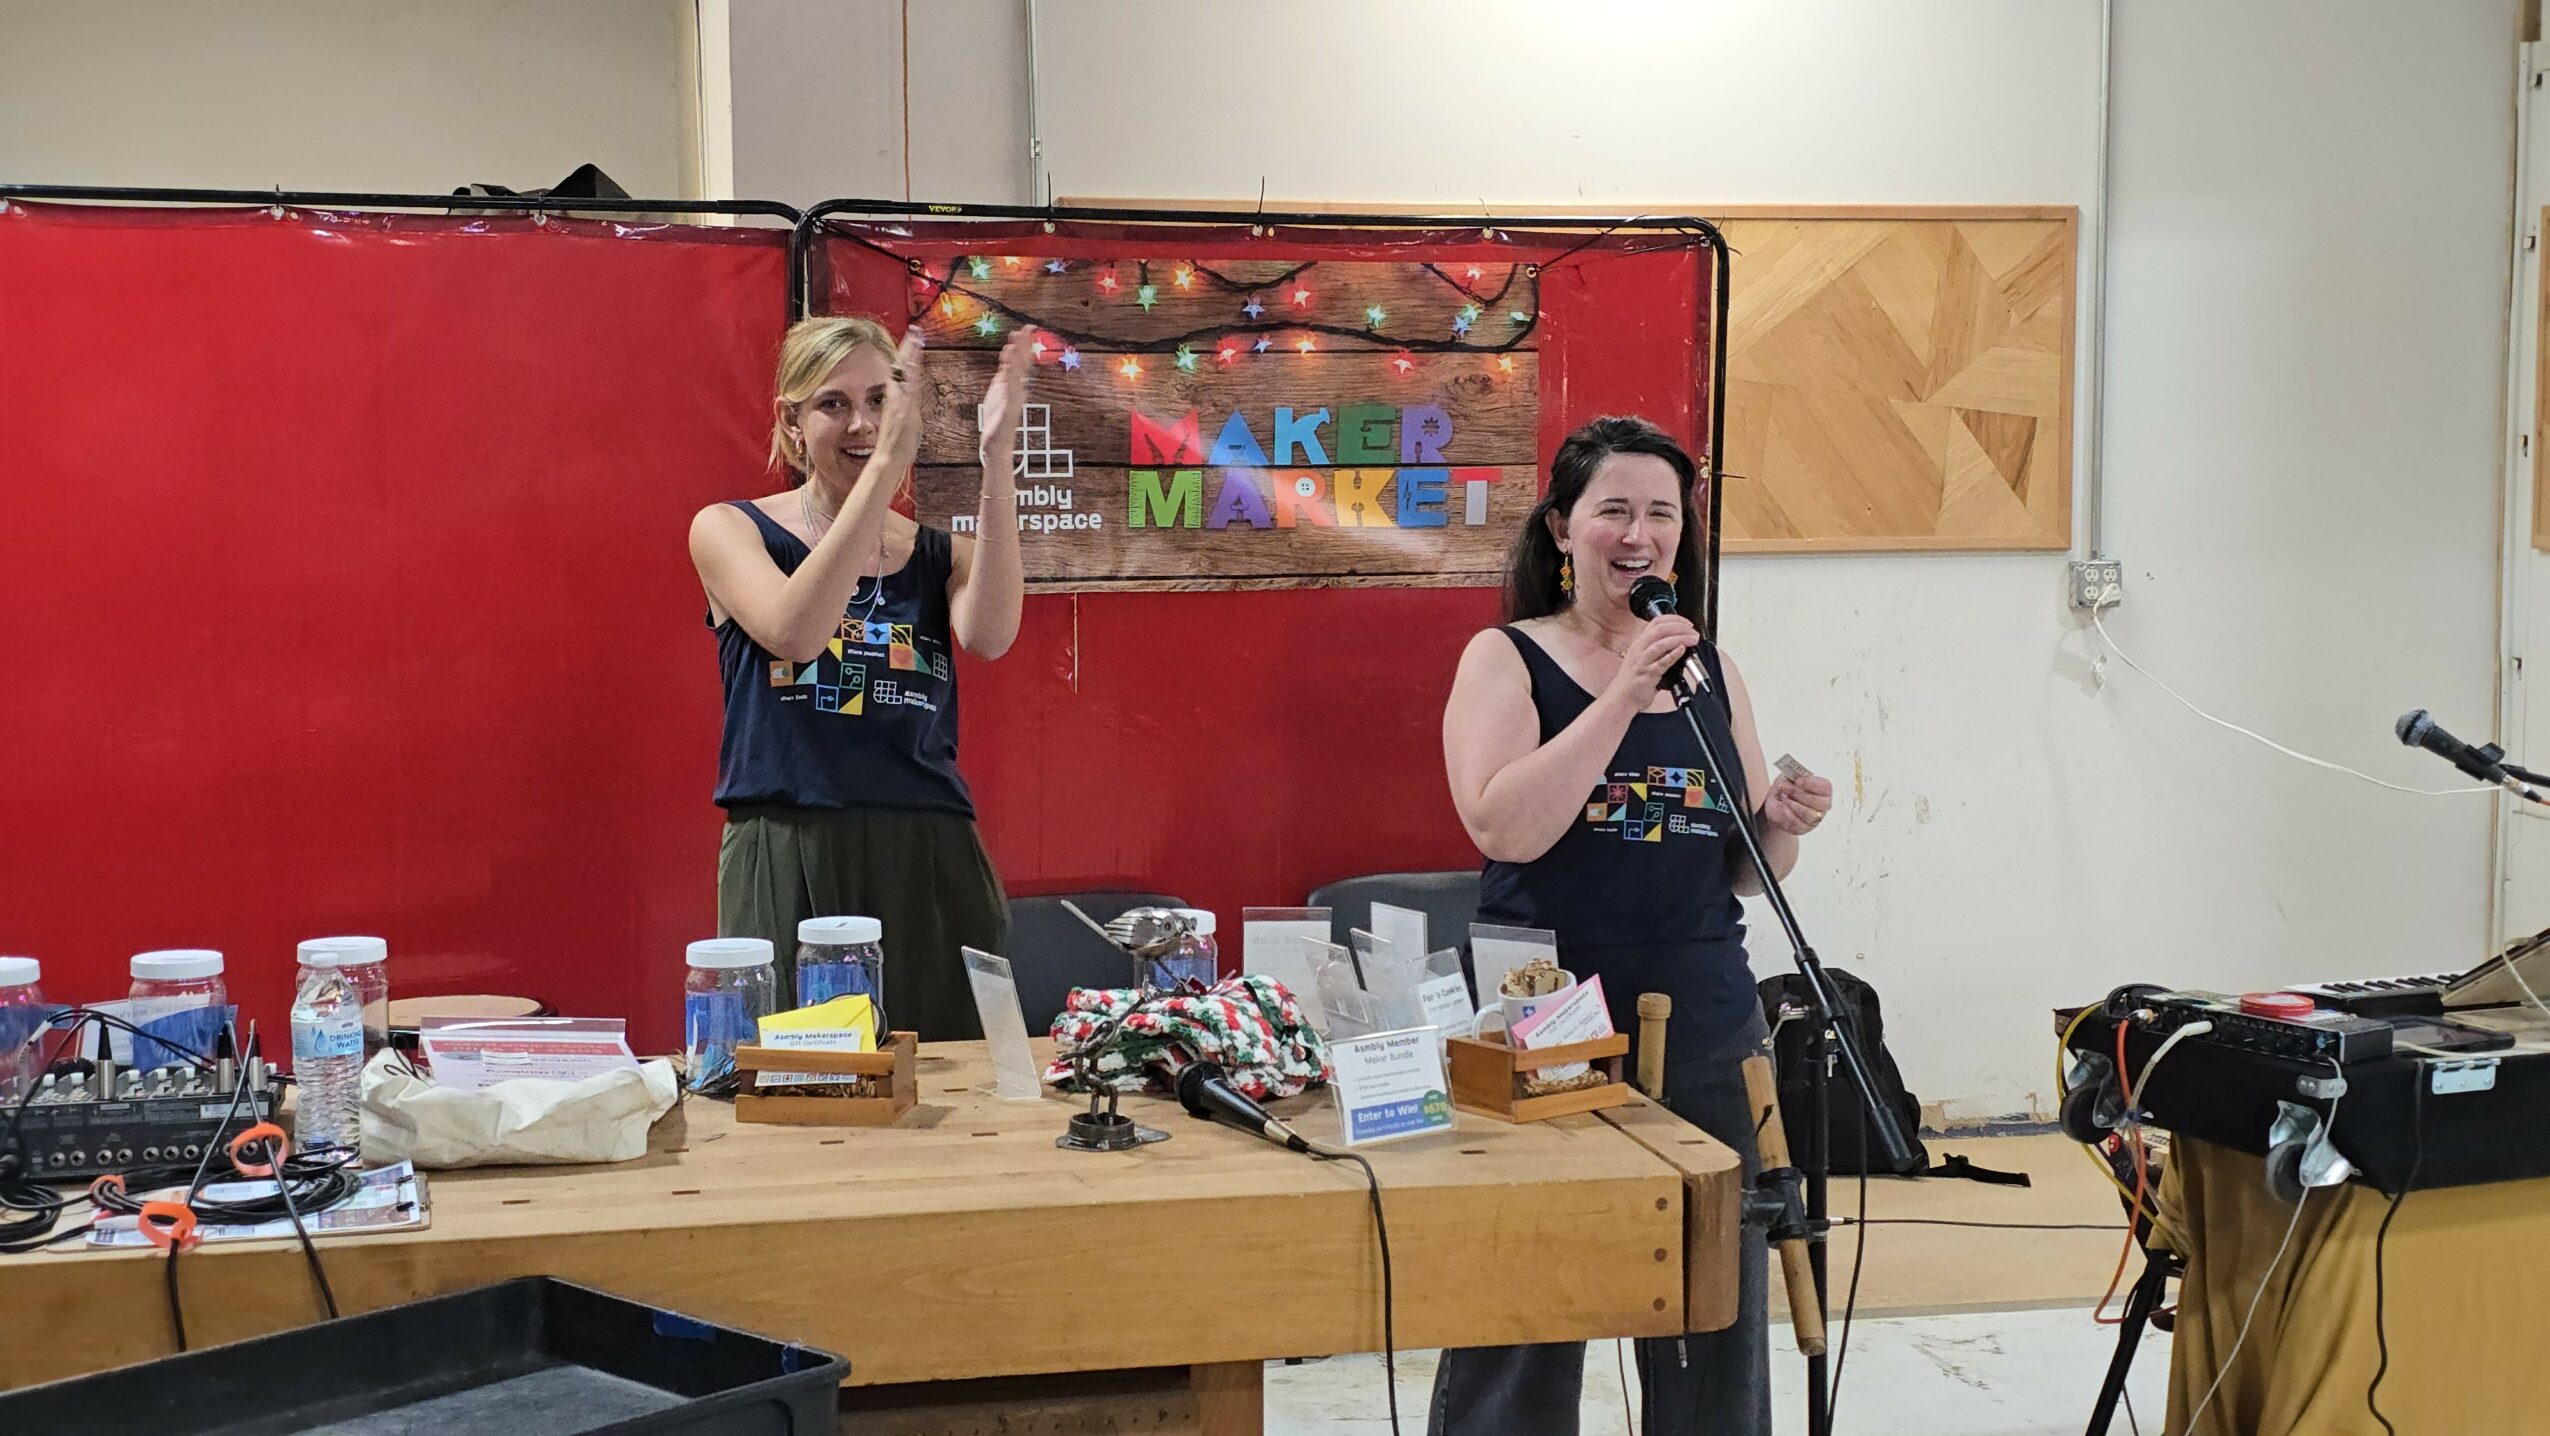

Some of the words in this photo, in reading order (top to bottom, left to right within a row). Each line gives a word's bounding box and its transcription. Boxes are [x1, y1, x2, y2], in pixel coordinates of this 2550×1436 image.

[928, 204, 958, 213] VEVOR
[1130, 406, 1454, 466] MAKER
[1015, 485, 1073, 509] mbly
[1128, 467, 1504, 529] MARKET
[952, 512, 1102, 534] mrspace
[805, 1031, 852, 1039] Makerspace
[1354, 1041, 1385, 1053] Asmbly
[1386, 1036, 1420, 1048] Member
[1357, 1110, 1382, 1123] Enter
[1384, 1108, 1395, 1118] to
[1397, 1103, 1419, 1116] Win!
